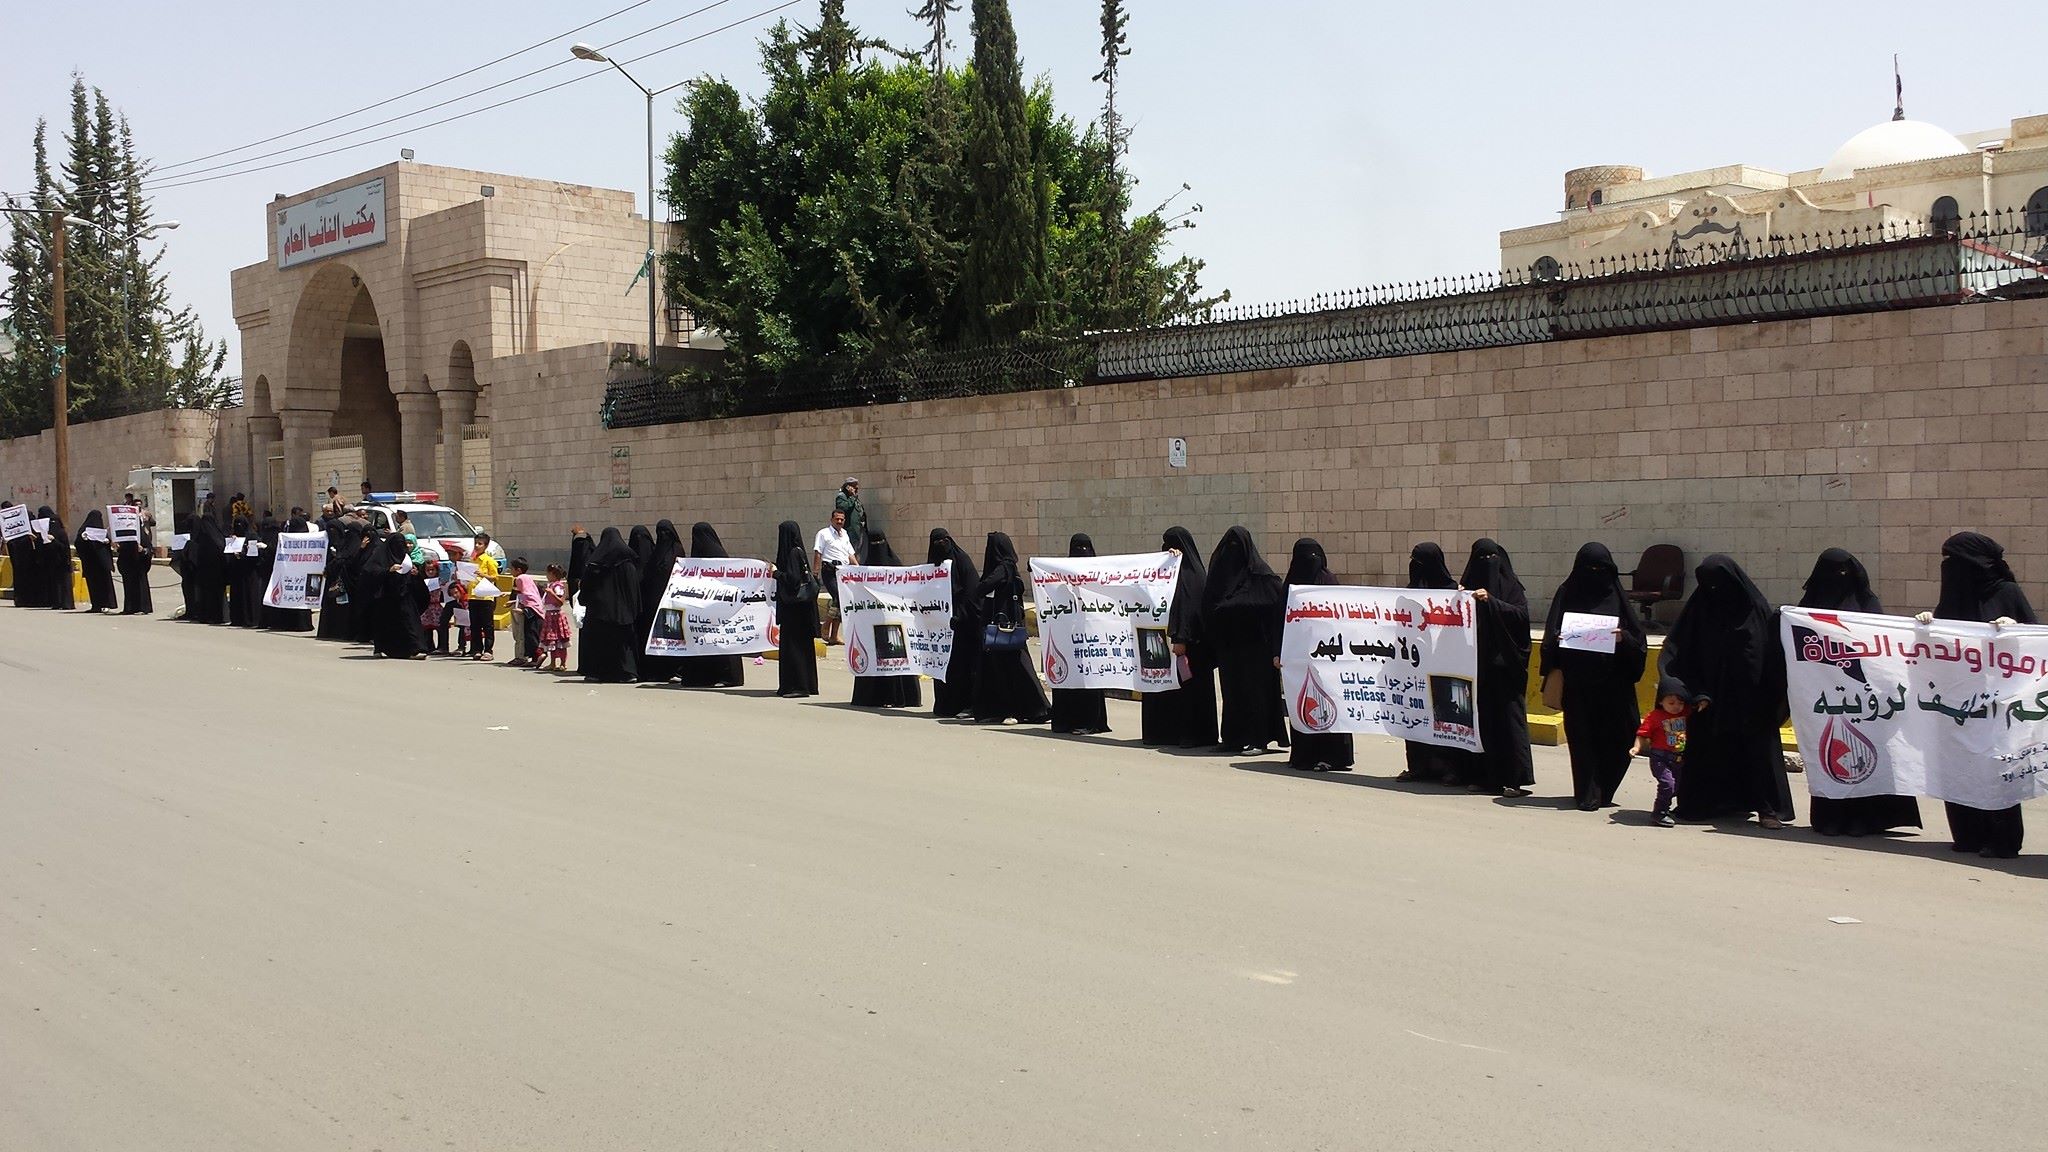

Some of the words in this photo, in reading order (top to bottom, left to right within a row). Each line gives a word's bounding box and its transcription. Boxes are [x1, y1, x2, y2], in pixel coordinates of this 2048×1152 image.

[308, 212, 340, 254] النائب
[342, 203, 376, 245] مكتب
[284, 222, 306, 265] العام
[725, 565, 750, 579] الصمت
[1100, 569, 1140, 585] يتعرضون
[1142, 566, 1176, 584] أبناؤنا
[740, 590, 767, 606] قضية
[843, 600, 867, 616] الحوثي
[1039, 596, 1078, 623] الحوثي
[1078, 596, 1116, 615] جماعة
[1117, 600, 1151, 618] سجون
[1151, 596, 1168, 622] في
[1286, 600, 1345, 624] المختطفين
[1345, 602, 1381, 625] أبنائنا
[1384, 608, 1413, 628] يهدد
[1417, 597, 1472, 632] الخطر
[1310, 632, 1343, 663] لهم
[1349, 636, 1396, 664] مجيب
[1397, 636, 1420, 668] ولا
[1803, 634, 1892, 669] الحياة
[1897, 638, 1982, 673] ولدي
[1343, 688, 1425, 710] #release_our_son
[1813, 682, 1907, 723] لرؤيته
[1917, 680, 1999, 727] أتلهف
